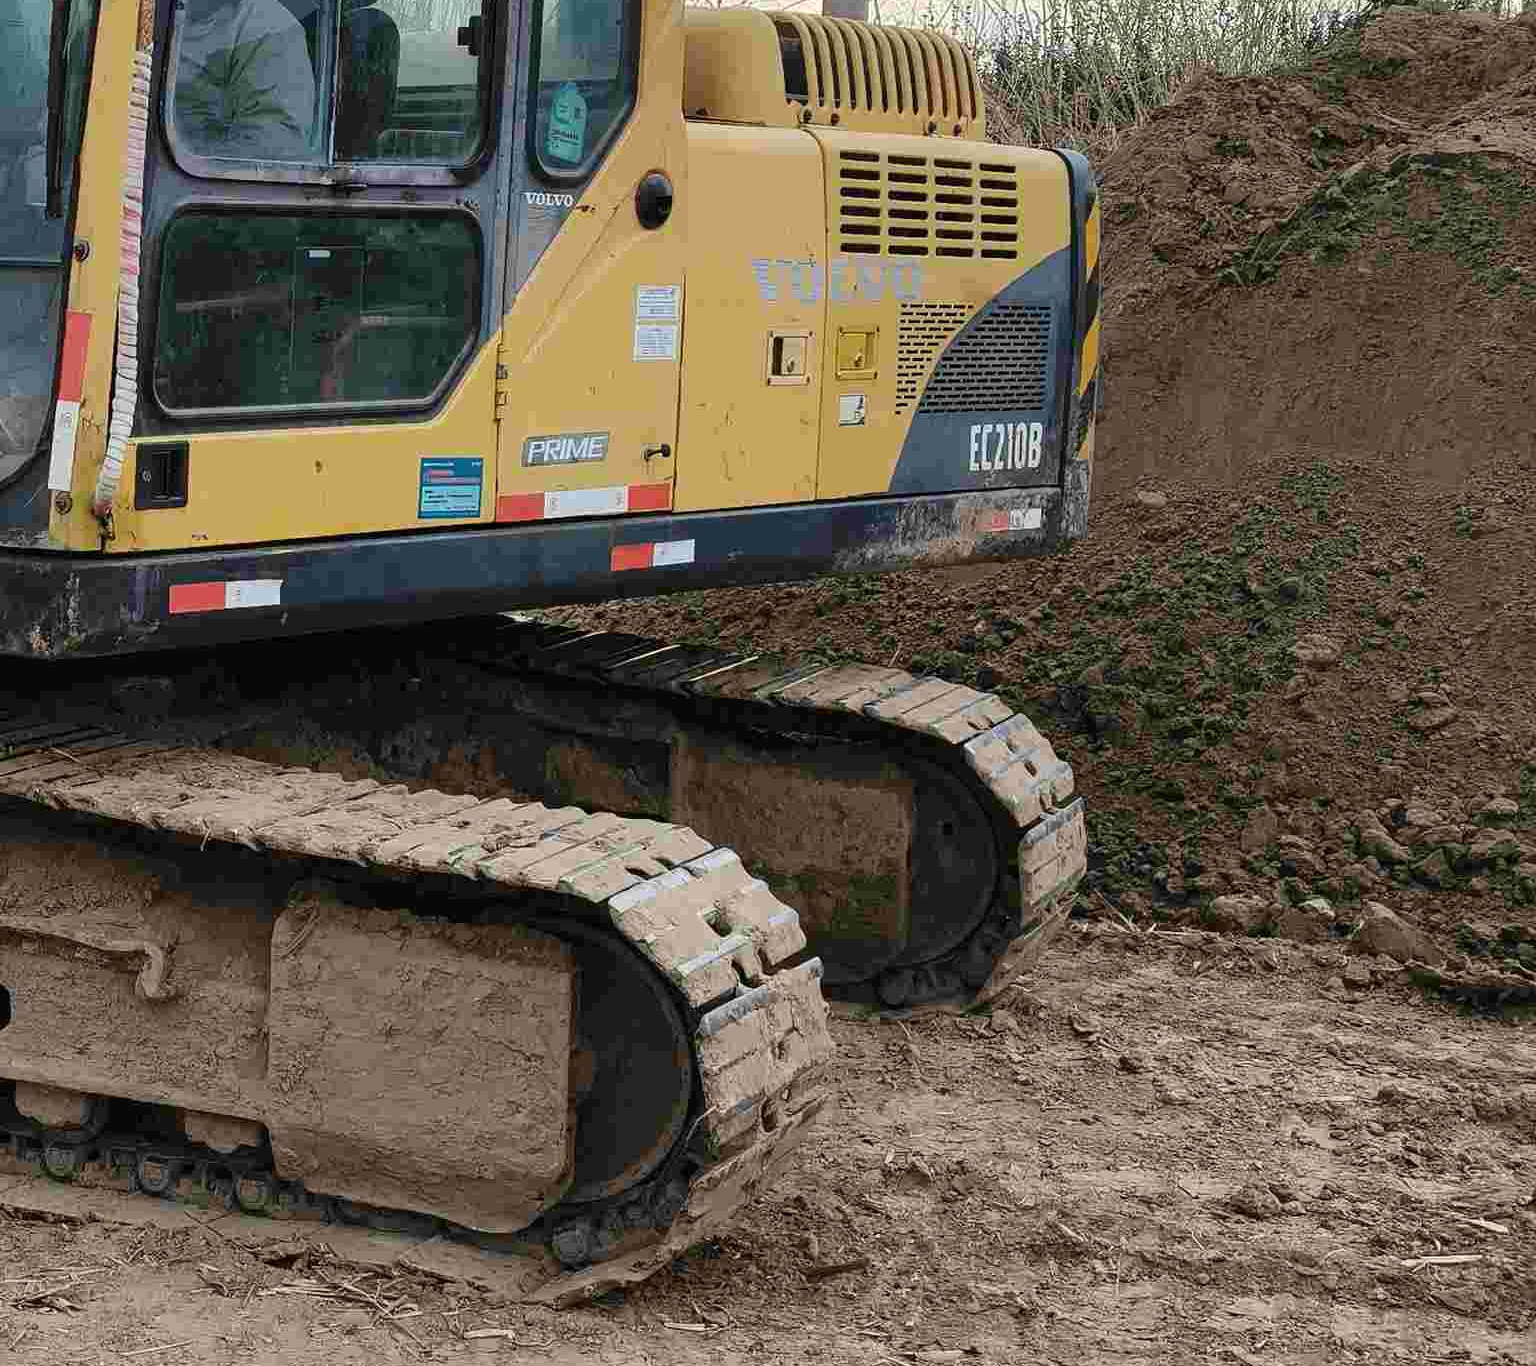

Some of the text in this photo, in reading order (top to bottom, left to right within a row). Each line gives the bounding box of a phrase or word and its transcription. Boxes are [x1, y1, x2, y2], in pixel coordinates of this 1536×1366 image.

[525, 192, 574, 206] VOLVO
[751, 258, 922, 301] VOLVO
[527, 435, 608, 464] PRIME
[969, 422, 1043, 471] EC210B
